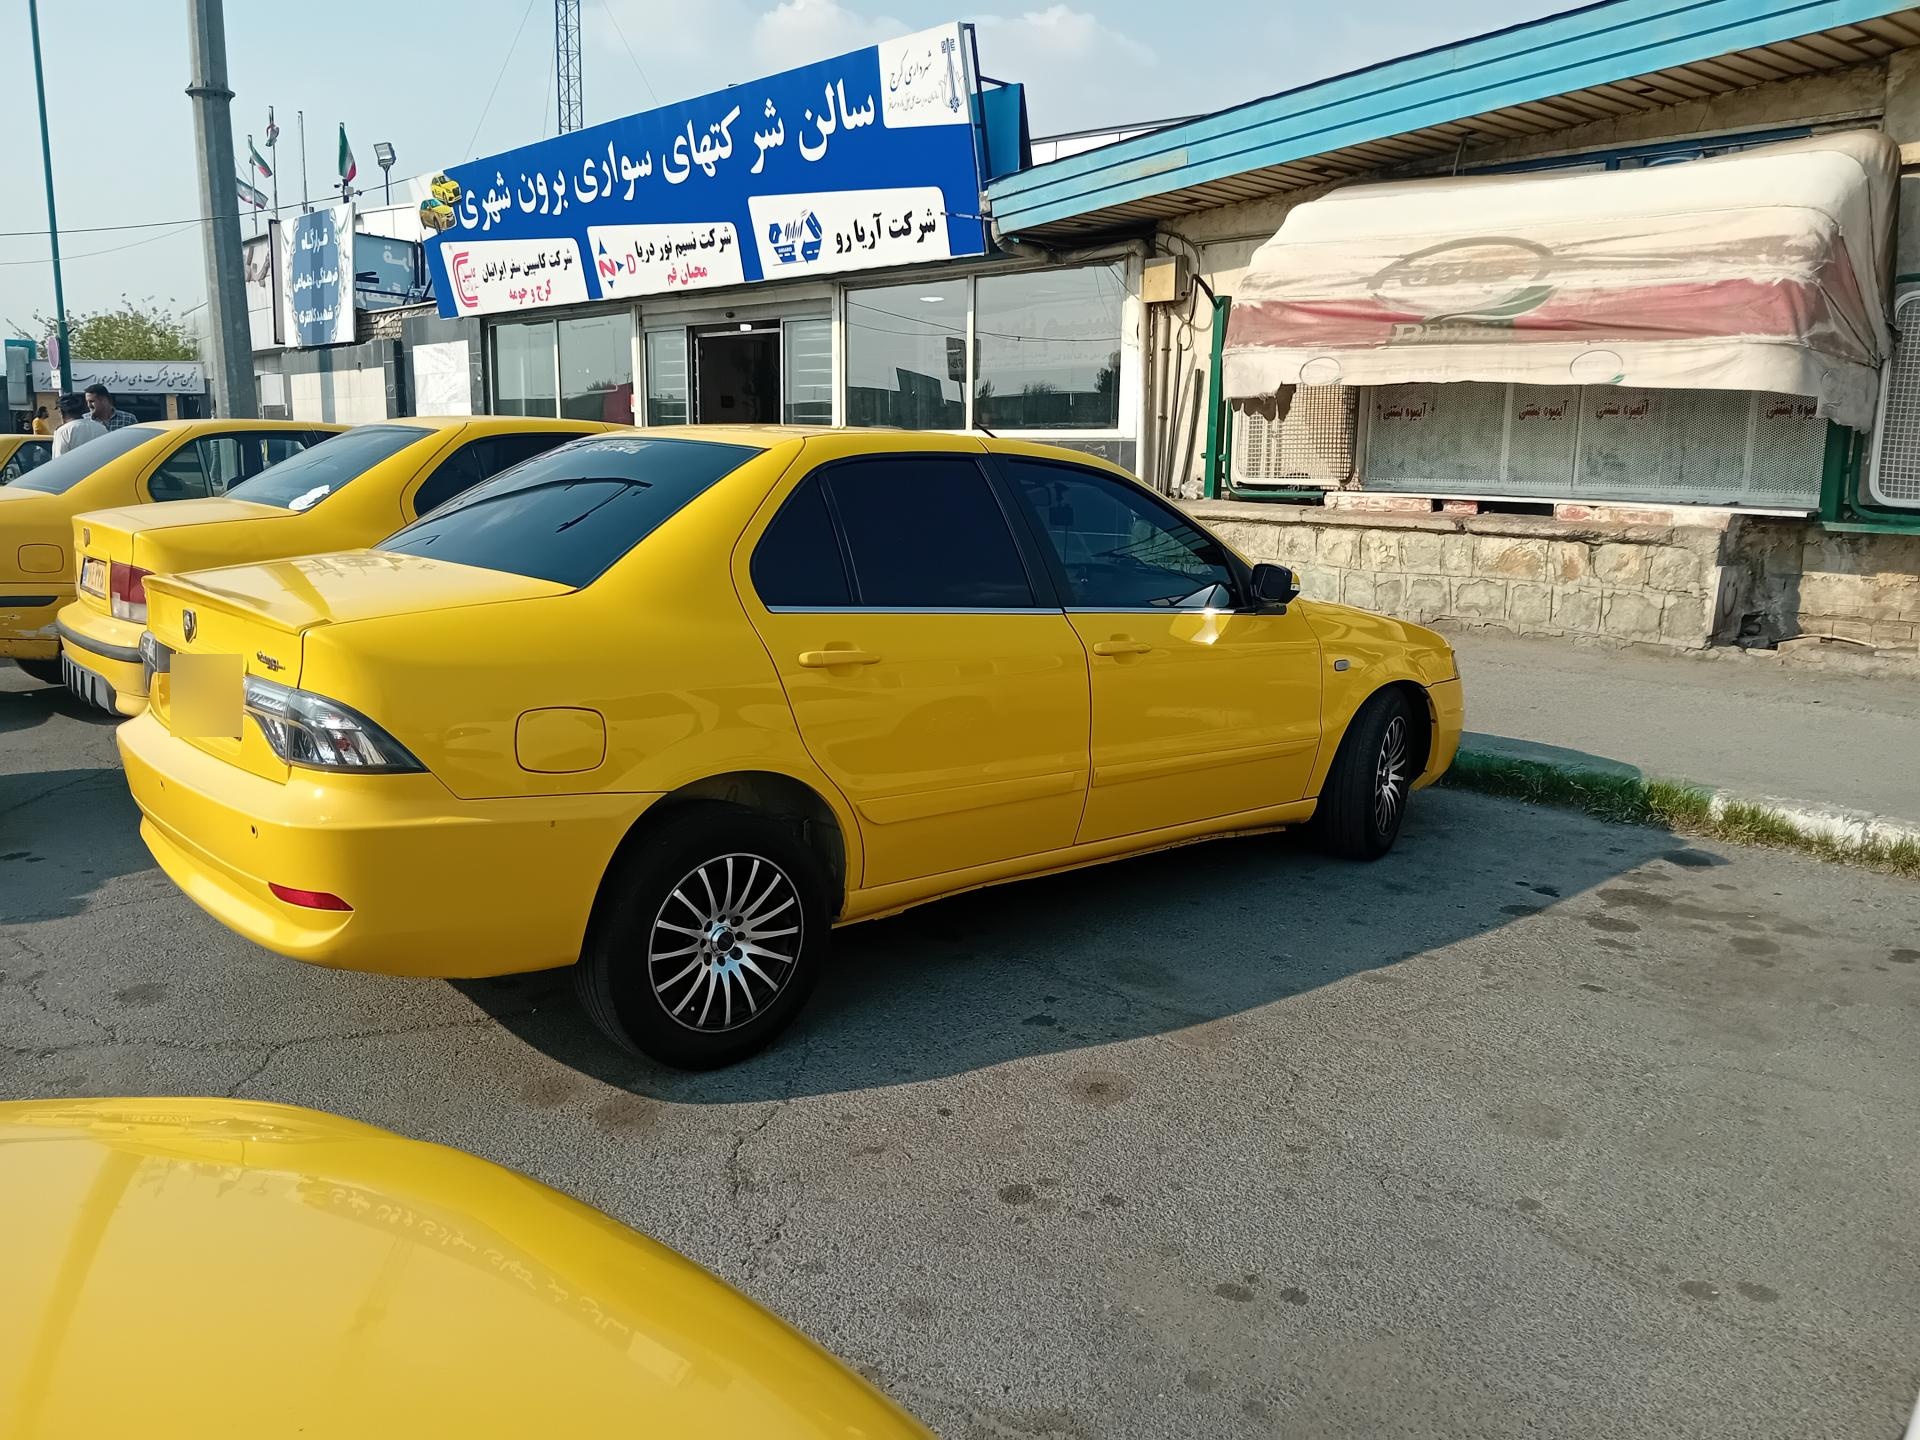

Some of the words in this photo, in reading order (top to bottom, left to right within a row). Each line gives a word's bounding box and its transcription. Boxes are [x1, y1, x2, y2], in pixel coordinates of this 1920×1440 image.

[890, 48, 909, 92] کرج
[905, 50, 932, 85] شهرداری
[799, 78, 875, 162] سالن
[573, 140, 653, 204] سواری
[459, 170, 512, 231] شهری
[518, 169, 569, 216] برون
[889, 208, 936, 243] شرکت
[301, 227, 328, 253] قرارگاه
[660, 235, 673, 261] نور
[675, 231, 697, 258] نسیم
[700, 226, 732, 253] شرکت
[549, 248, 573, 271] شرکت
[635, 240, 655, 263] دریا
[482, 260, 507, 283] ایرانیان
[510, 258, 521, 279] سفر
[523, 252, 546, 277] کاسپین
[667, 262, 677, 286] قم
[680, 262, 708, 285] محبان
[294, 270, 315, 292] اجتماعی
[316, 266, 338, 288] فرهنگی
[509, 287, 527, 304] حومه
[531, 288, 536, 304] و
[538, 279, 551, 301] کرج
[317, 304, 333, 325] شهید
[144, 364, 168, 386] شرکت
[181, 366, 197, 388] انجمن
